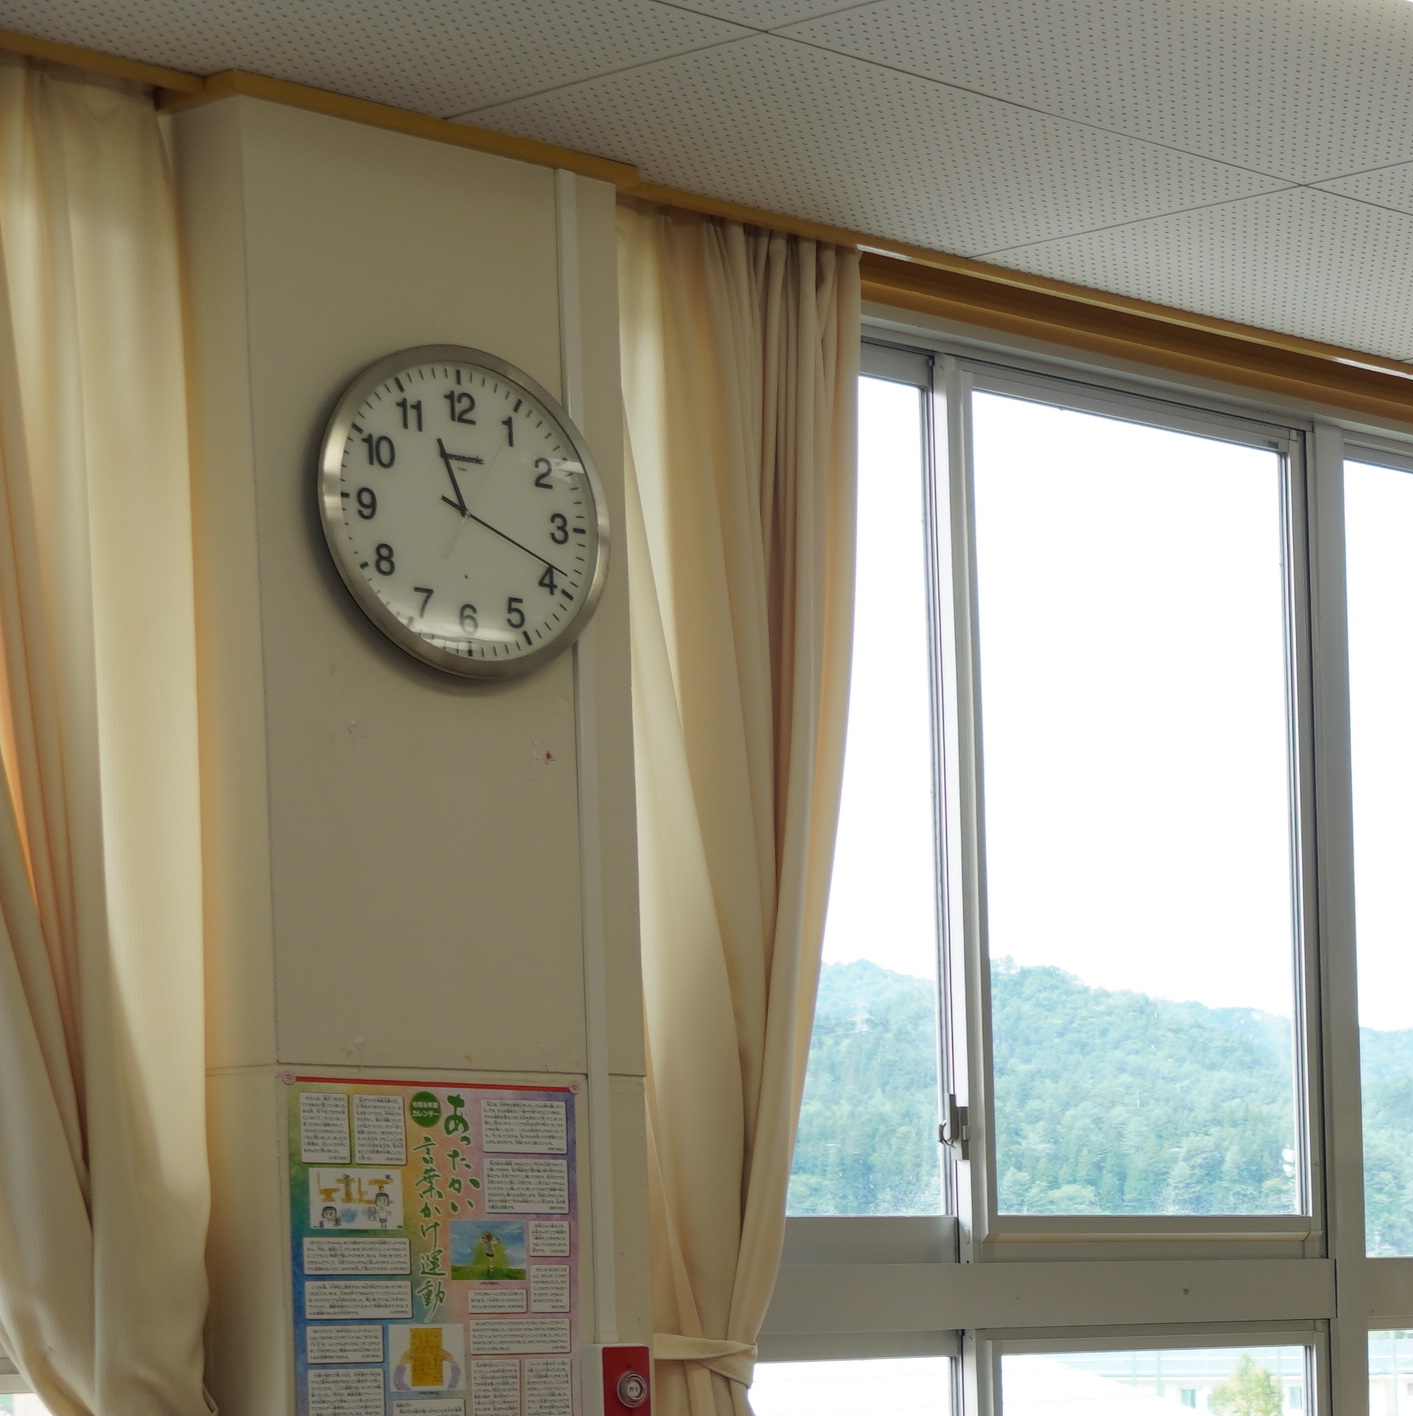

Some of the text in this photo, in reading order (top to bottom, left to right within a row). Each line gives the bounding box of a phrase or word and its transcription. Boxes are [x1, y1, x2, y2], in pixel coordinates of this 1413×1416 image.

[395, 397, 423, 432] 11
[443, 389, 477, 425] 12
[501, 416, 514, 447] 1
[362, 433, 396, 468] 10
[533, 457, 554, 490] 2
[356, 487, 377, 520] 9
[549, 513, 570, 545] 3
[374, 543, 396, 576] 8
[538, 565, 558, 596] 4
[413, 586, 434, 618] 7
[506, 597, 526, 629] 5
[459, 604, 479, 635] 6
[444, 1094, 481, 1213] あったかい
[412, 1135, 447, 1321] 言葉かけ運動
